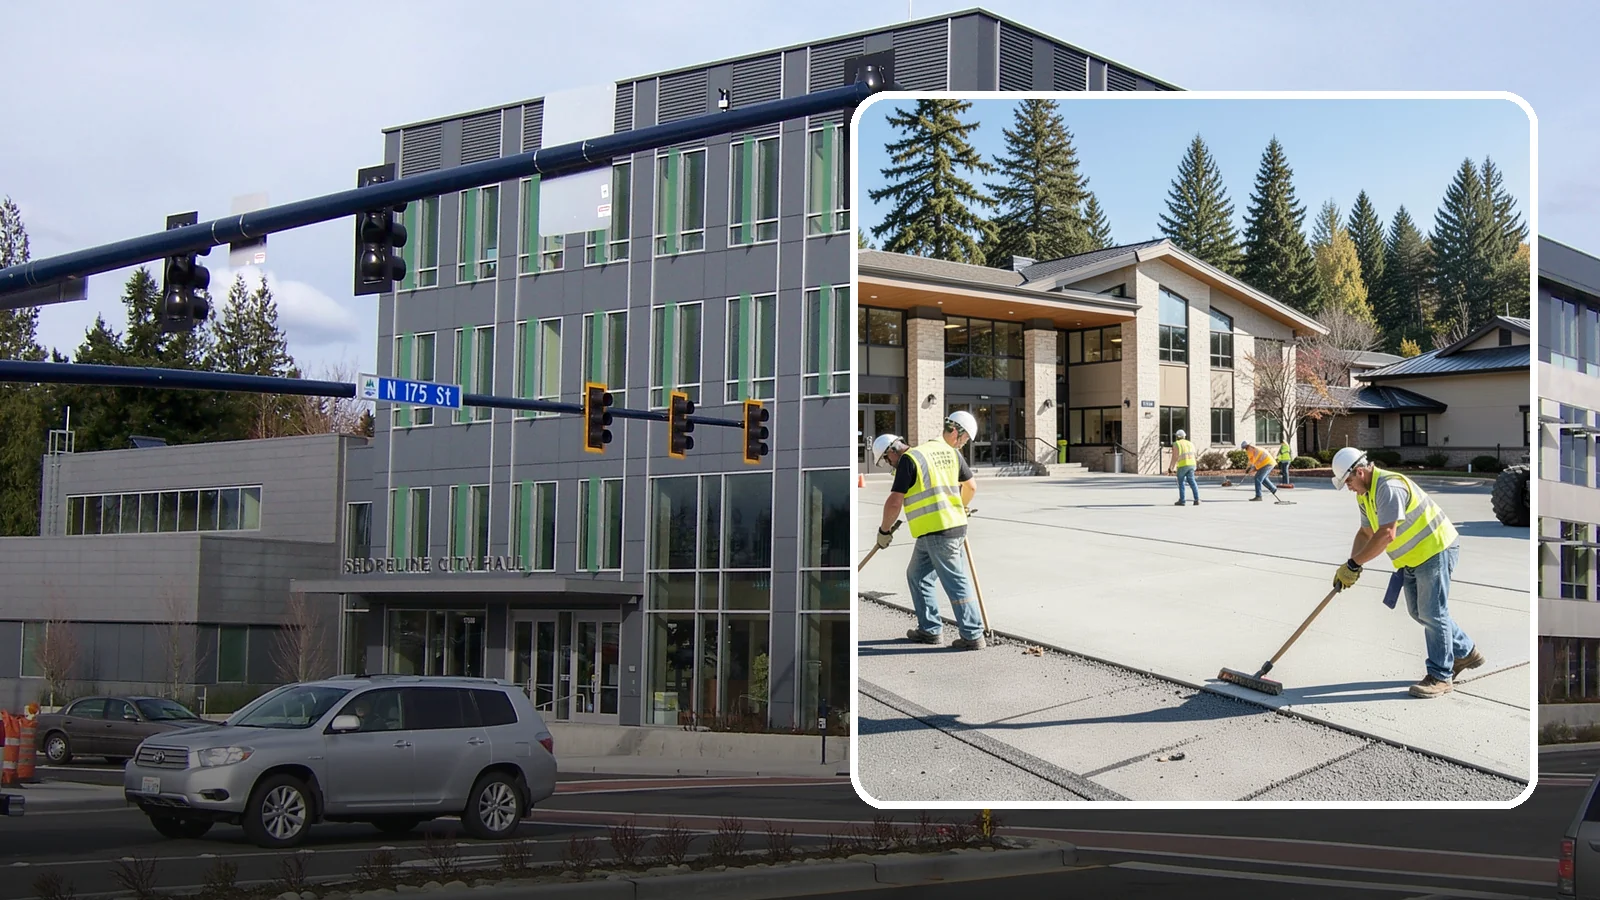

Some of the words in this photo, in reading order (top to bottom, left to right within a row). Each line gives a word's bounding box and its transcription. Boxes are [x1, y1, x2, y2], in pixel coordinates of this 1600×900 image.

[387, 380, 396, 399] N
[405, 383, 427, 403] 175
[436, 386, 451, 406] St
[344, 556, 432, 574] SHORELINE
[438, 556, 476, 573] CITY
[483, 555, 526, 572] HALL
